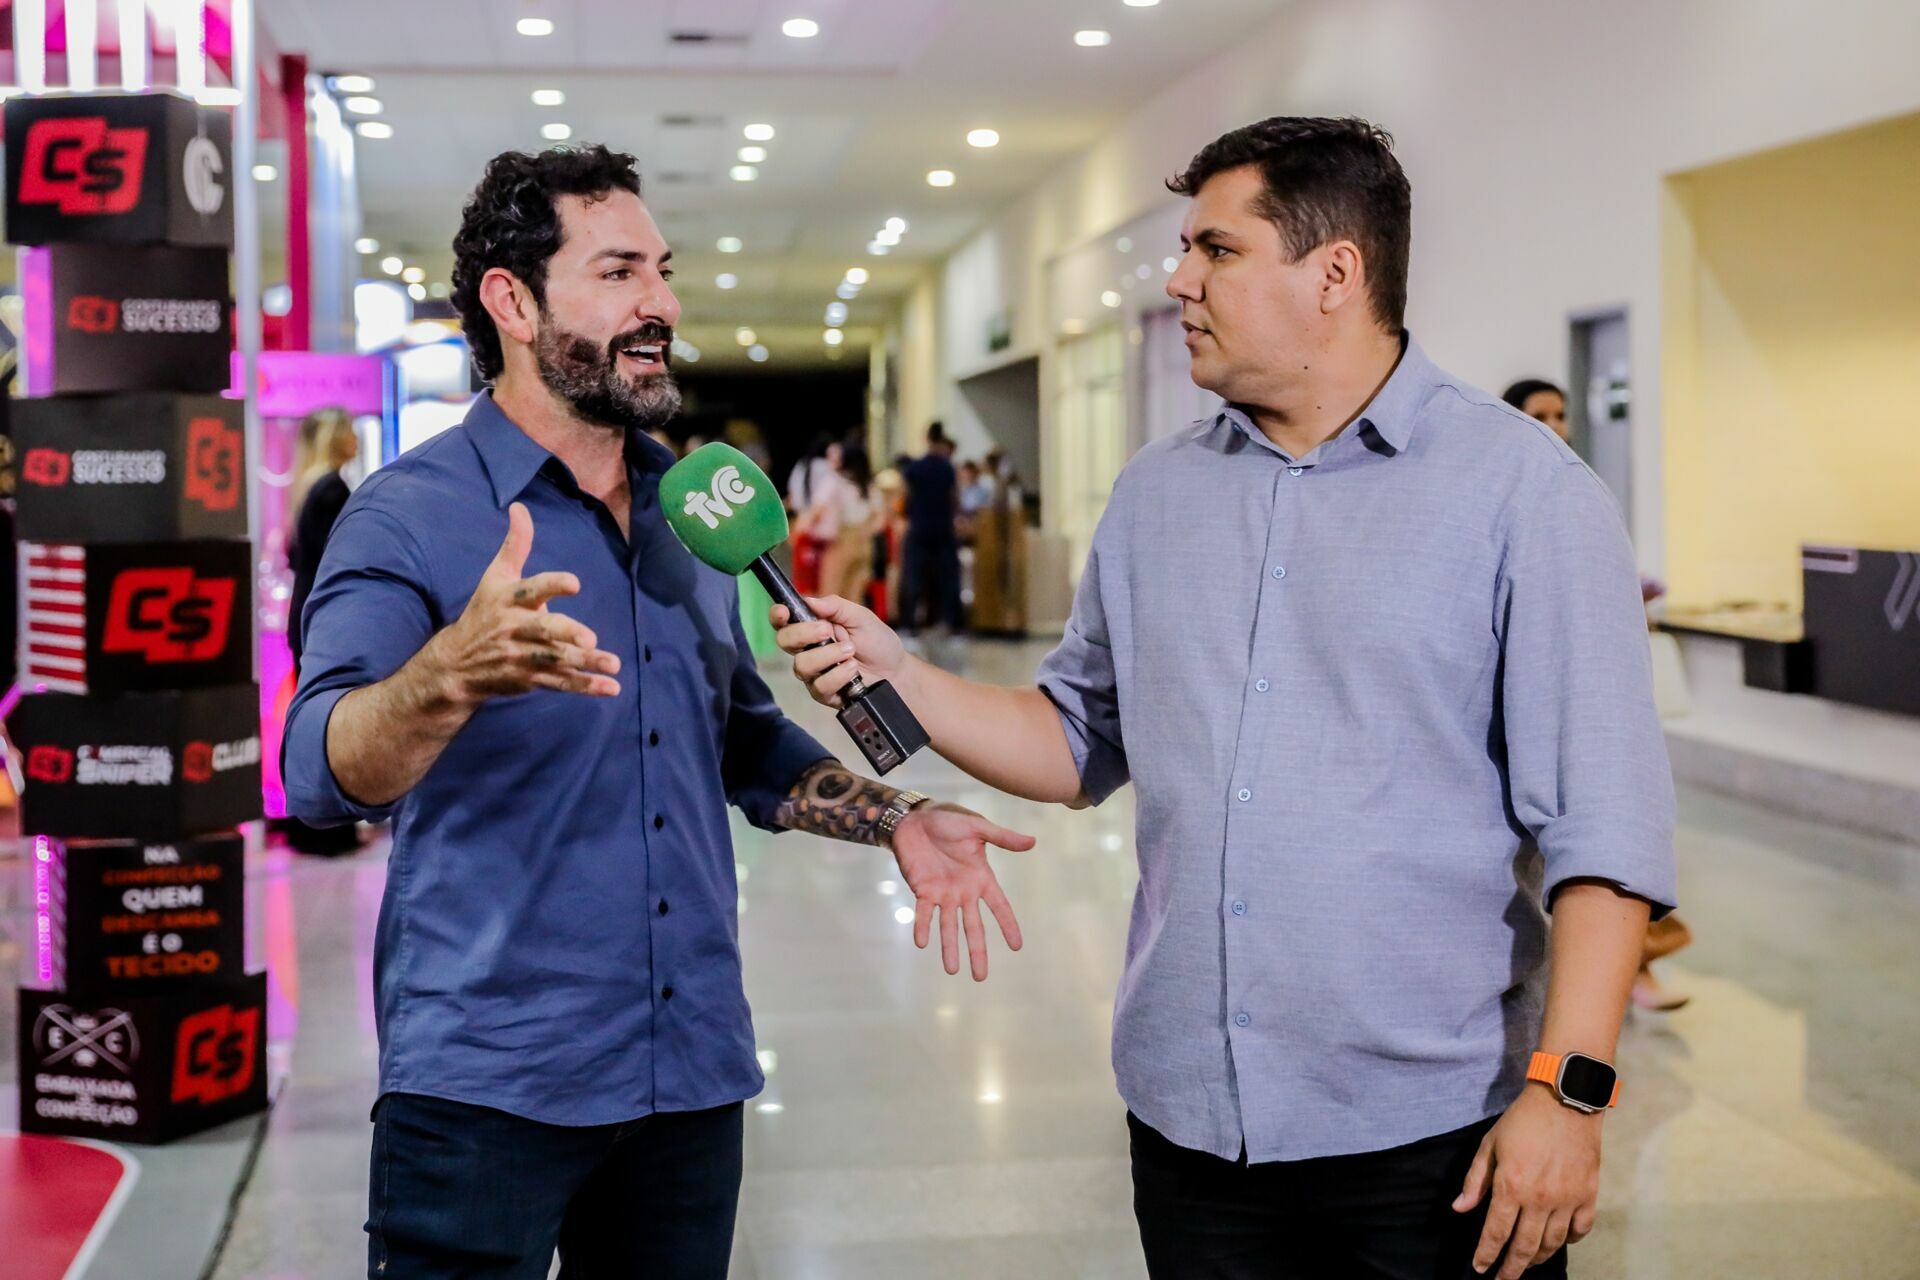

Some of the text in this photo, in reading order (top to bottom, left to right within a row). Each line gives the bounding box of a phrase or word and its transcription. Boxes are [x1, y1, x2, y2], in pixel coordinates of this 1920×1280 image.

[43, 138, 125, 193] CS
[122, 311, 221, 332] SUCESSO
[73, 462, 166, 484] SUCESSO
[127, 587, 213, 644] CS
[121, 885, 204, 914] QUEM
[187, 1028, 245, 1081] CS
